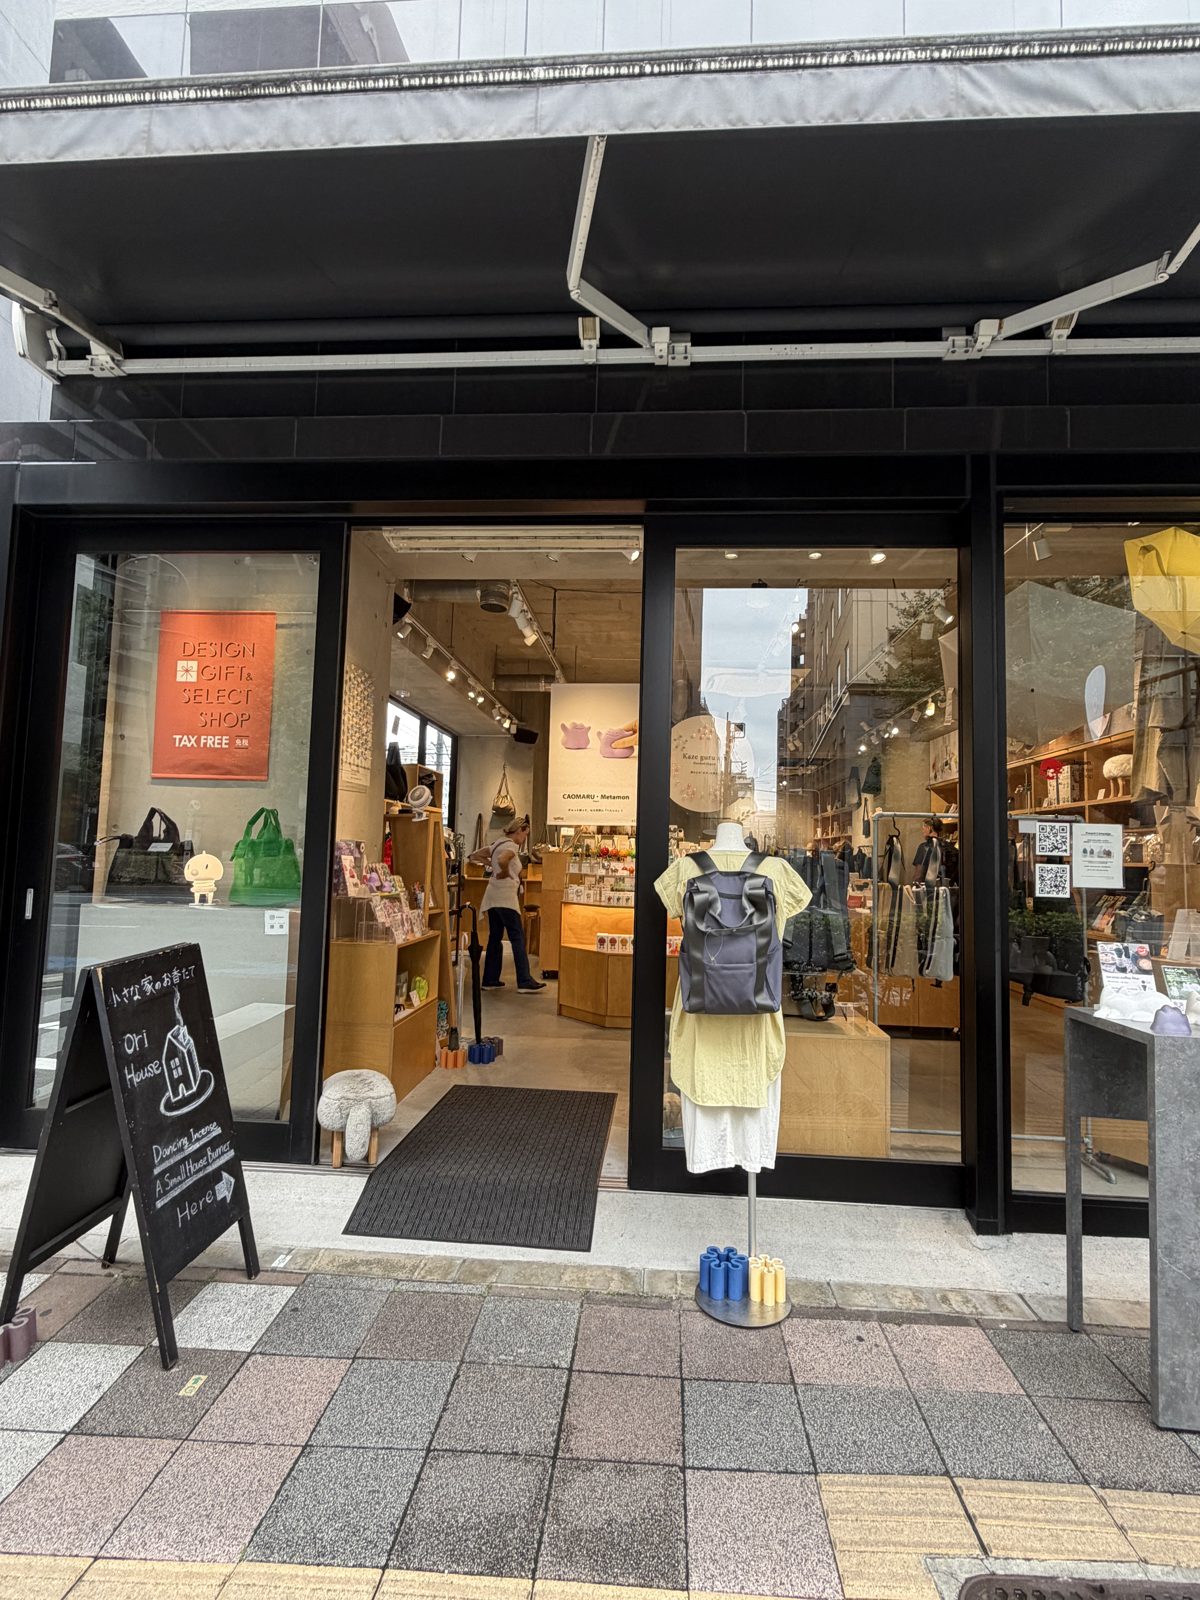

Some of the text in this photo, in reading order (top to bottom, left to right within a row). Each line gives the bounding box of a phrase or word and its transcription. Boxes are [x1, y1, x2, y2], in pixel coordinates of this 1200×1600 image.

[182, 642, 255, 658] DESIGN
[182, 688, 252, 705] SELECT
[200, 712, 251, 728] SHOP
[173, 735, 229, 748] TAX FREE
[110, 966, 196, 1008] 小さな家のお香たて
[124, 1029, 149, 1054] Ori
[124, 1060, 162, 1088] House
[152, 1121, 219, 1165] Dancing Incense
[155, 1179, 163, 1198] A
[164, 1164, 186, 1190] Small
[185, 1157, 208, 1177] House
[176, 1190, 214, 1228] Here
